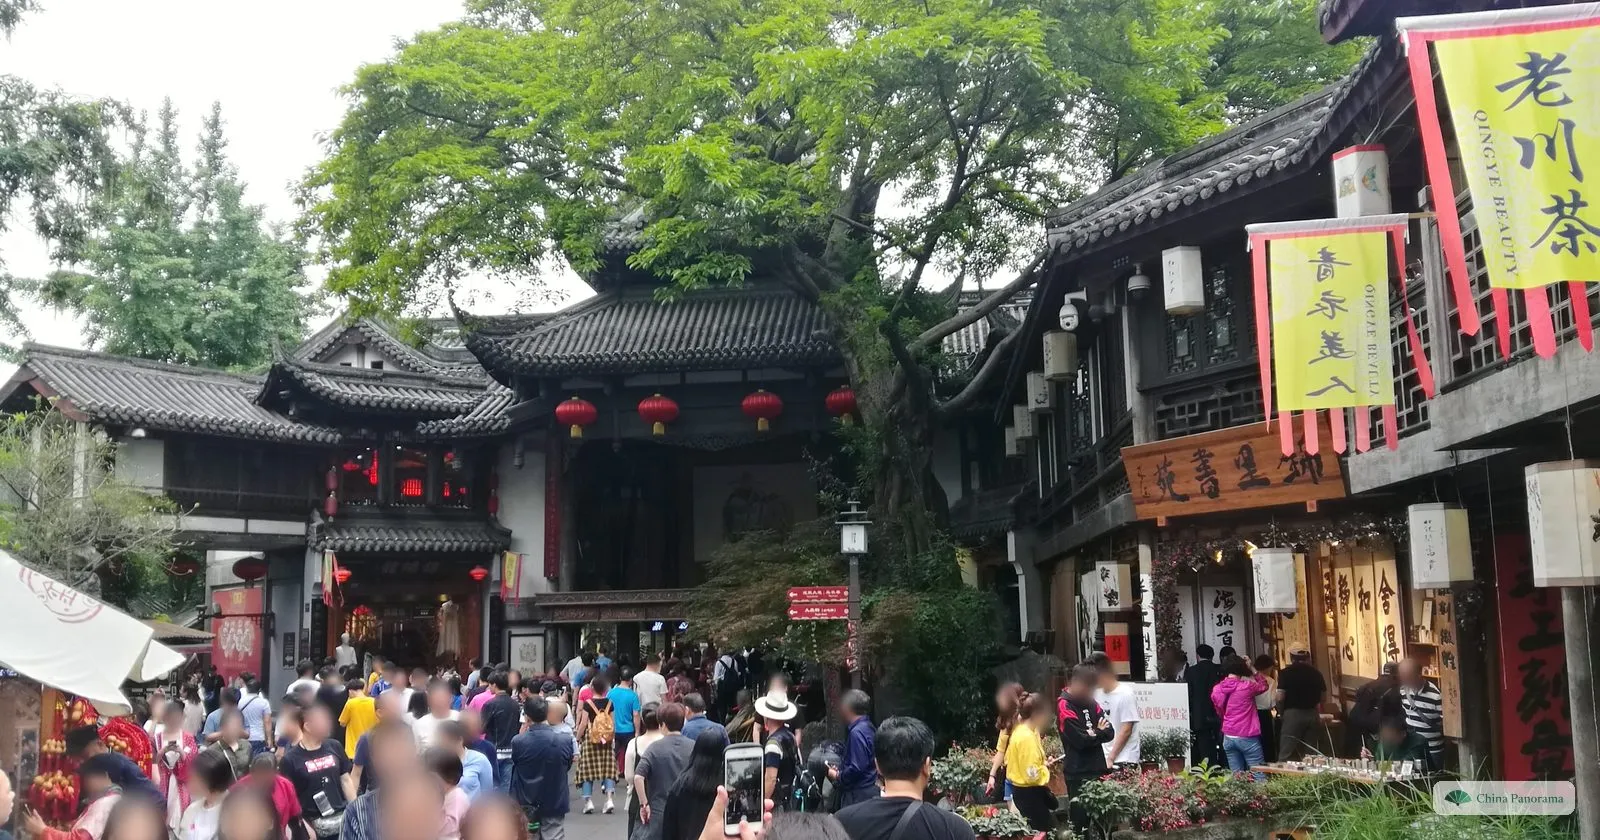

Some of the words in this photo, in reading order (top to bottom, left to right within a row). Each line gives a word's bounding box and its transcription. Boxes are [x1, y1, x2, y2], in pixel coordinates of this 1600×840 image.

[1473, 109, 1502, 188] QINGYE
[1492, 195, 1519, 278] BEAUTY
[1495, 51, 1600, 258] 老川茶
[1358, 575, 1372, 619] 和
[1378, 567, 1400, 663] 舍得
